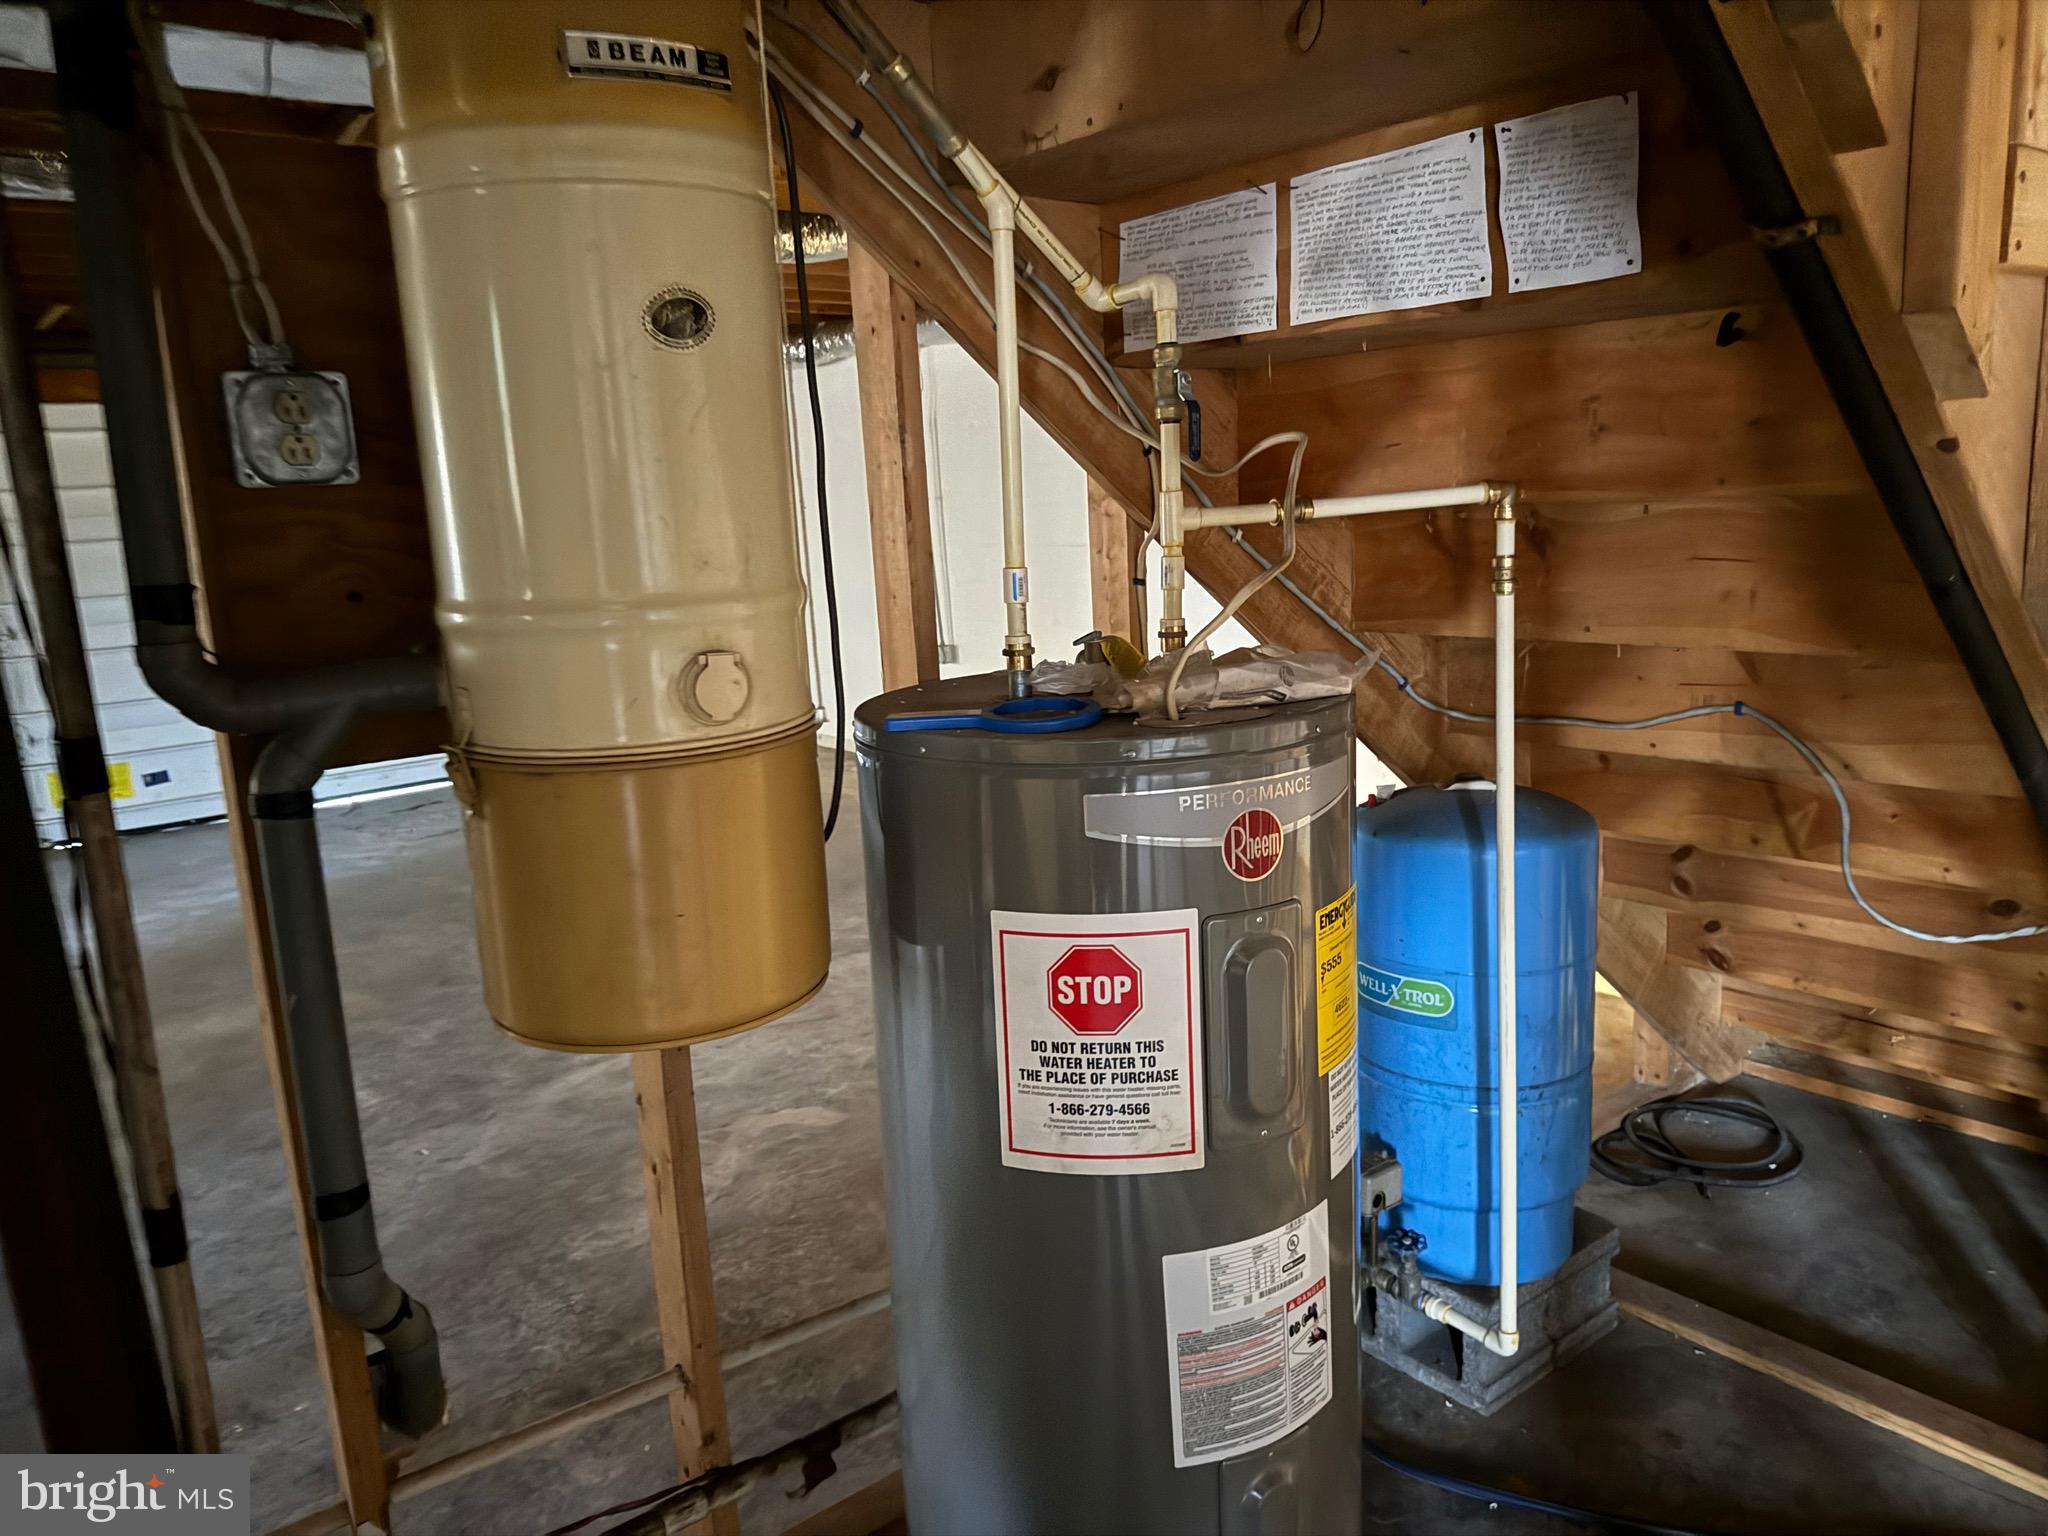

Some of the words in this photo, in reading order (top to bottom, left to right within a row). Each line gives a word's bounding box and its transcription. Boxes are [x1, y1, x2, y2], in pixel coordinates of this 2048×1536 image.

[608, 42, 687, 68] BEAM
[1179, 775, 1312, 812] PERFORMANCE
[1230, 813, 1280, 870] Rheem
[1320, 952, 1342, 976] $555
[1057, 975, 1132, 1005] STOP
[1031, 1040, 1048, 1053] DO
[1052, 1042, 1076, 1054] NOT
[1081, 1042, 1131, 1054] RETURN
[1136, 1040, 1165, 1053] THIS
[1040, 1055, 1082, 1069] WATER
[1087, 1057, 1135, 1069] HEATER
[1140, 1055, 1157, 1068] TO
[1019, 1068, 1042, 1082] THE
[1047, 1071, 1086, 1084] PLACE
[1090, 1072, 1107, 1085] OF
[1111, 1068, 1179, 1084] PURCHASE
[1048, 1102, 1150, 1116] 1-866-279-4566
